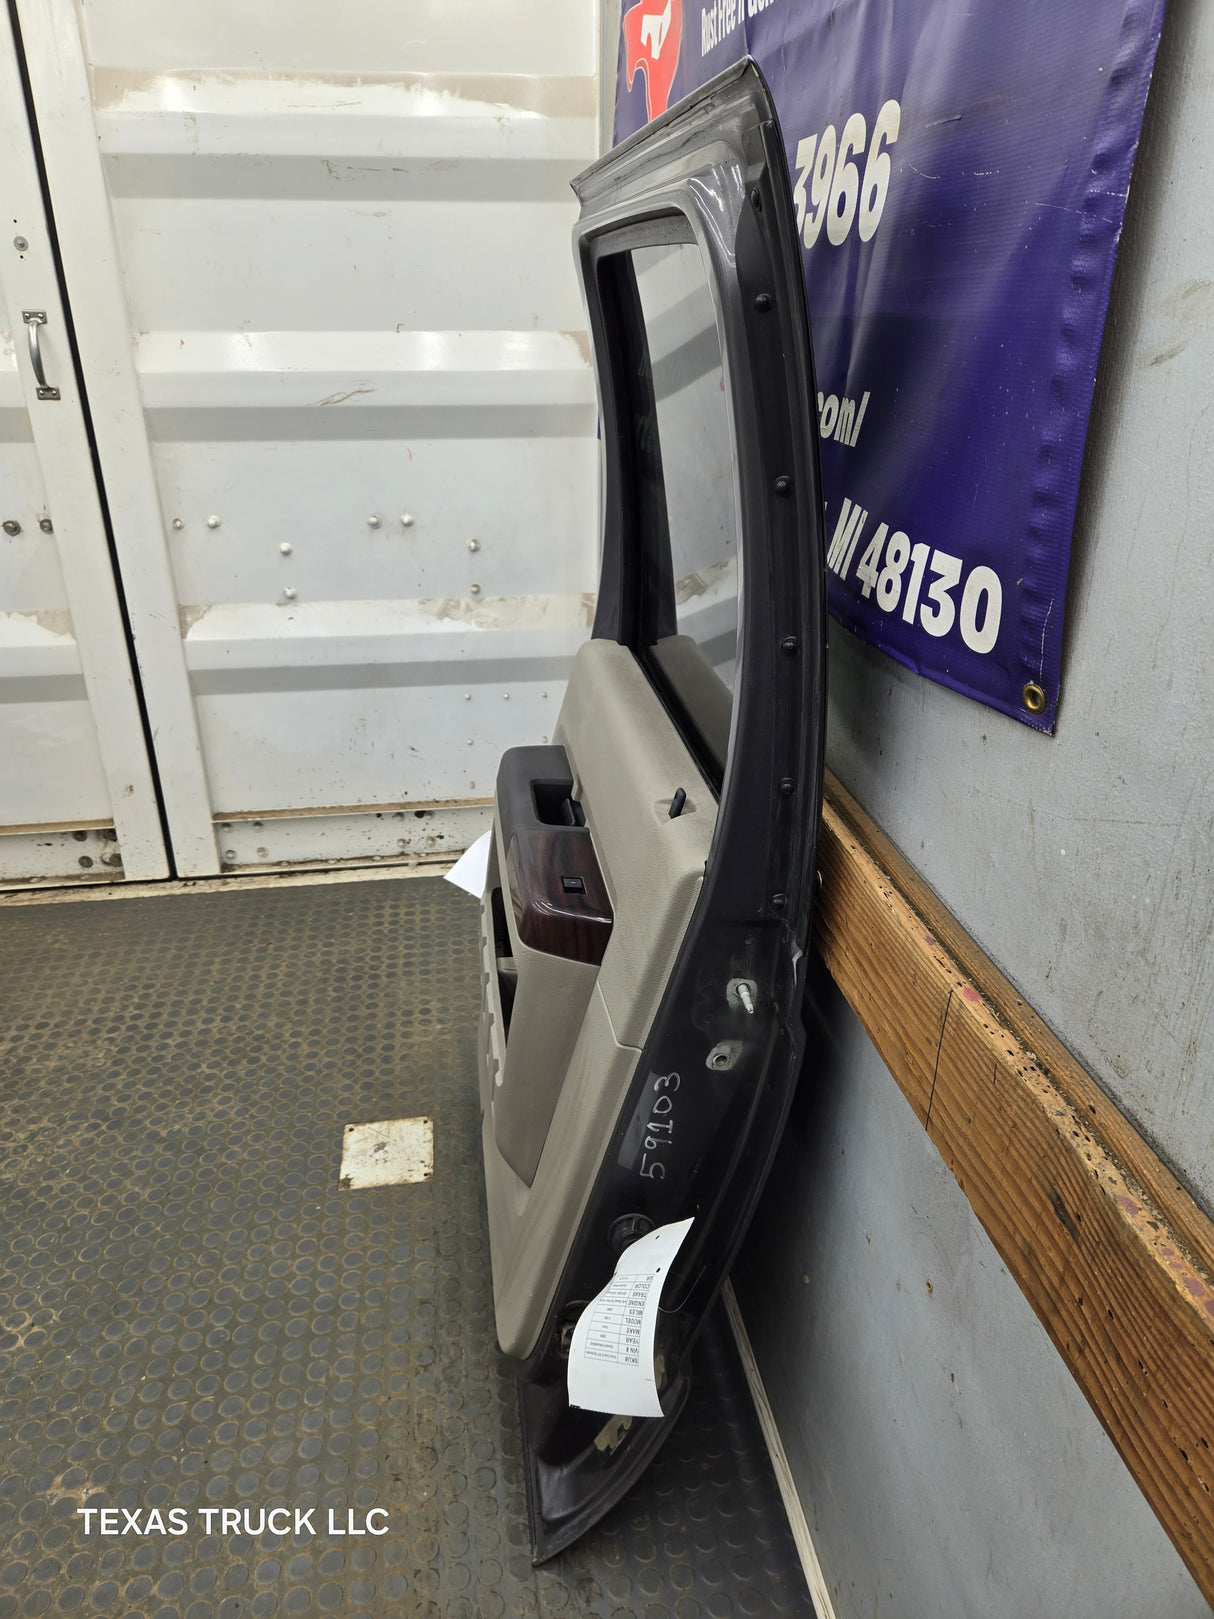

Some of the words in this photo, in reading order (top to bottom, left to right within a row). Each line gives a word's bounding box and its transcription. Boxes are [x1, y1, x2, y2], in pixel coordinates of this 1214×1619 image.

[701, 1, 717, 57] Rust
[793, 99, 901, 249] 3966
[827, 497, 869, 581] MI
[856, 522, 1003, 654] 48130
[640, 1072, 681, 1180] 59103
[625, 1317, 641, 1325] MODEL
[626, 1327, 640, 1335] MAKE
[625, 1336, 639, 1344] YEAR
[630, 1347, 639, 1355] VIN
